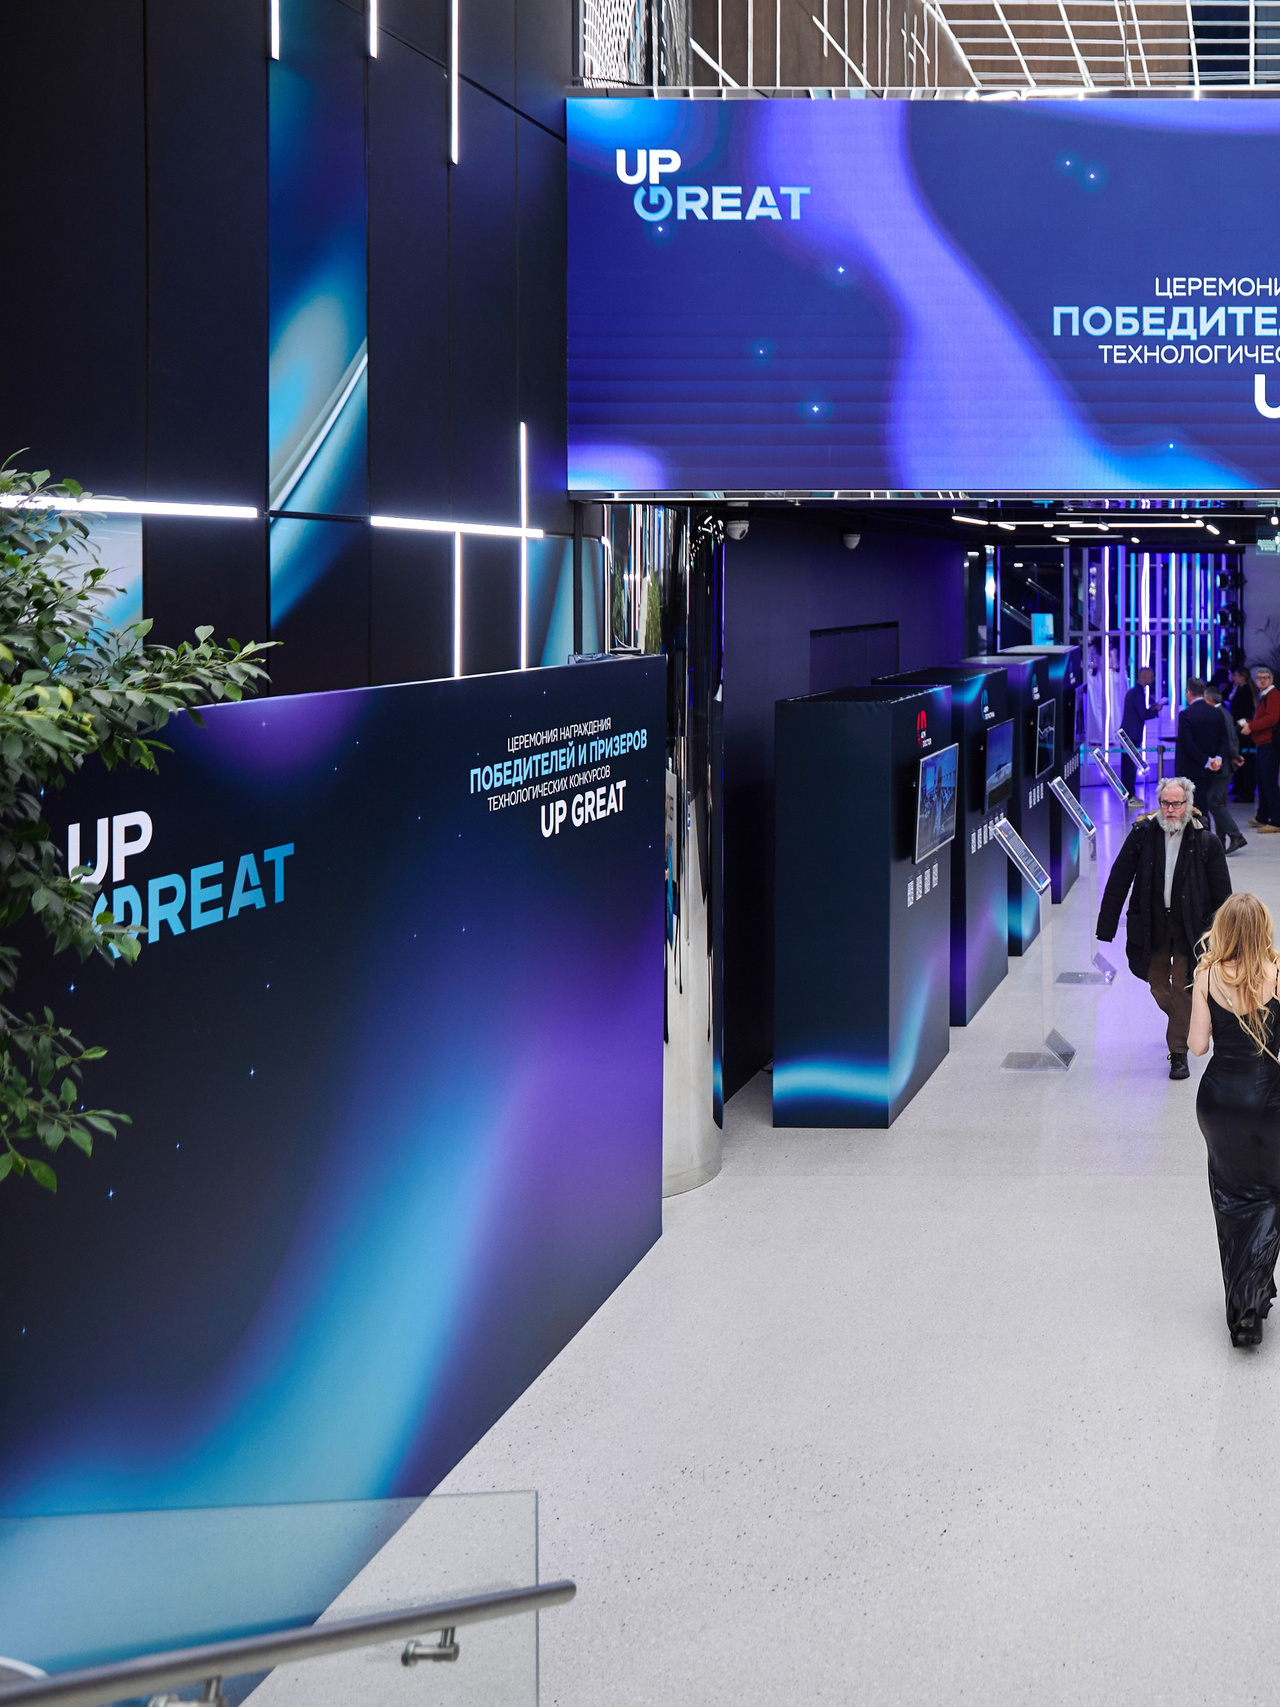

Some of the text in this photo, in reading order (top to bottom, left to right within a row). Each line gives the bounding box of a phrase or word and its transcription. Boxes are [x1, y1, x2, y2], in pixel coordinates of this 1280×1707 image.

[617, 149, 682, 185] UP
[634, 185, 811, 221] GREAT
[507, 716, 612, 753] ЦЕРЕМОНИЯ НАГРАЖДЕНИЯ
[470, 728, 648, 794] ПОБЕДИТЕЛЕЙ И ПРИЗЕРОВ
[487, 764, 611, 812] ТЕХНОЛОГИЧЕСКИХ КОНКУРСОВ
[540, 799, 568, 838] UP
[571, 780, 627, 828] GREAT
[67, 810, 153, 885] UP
